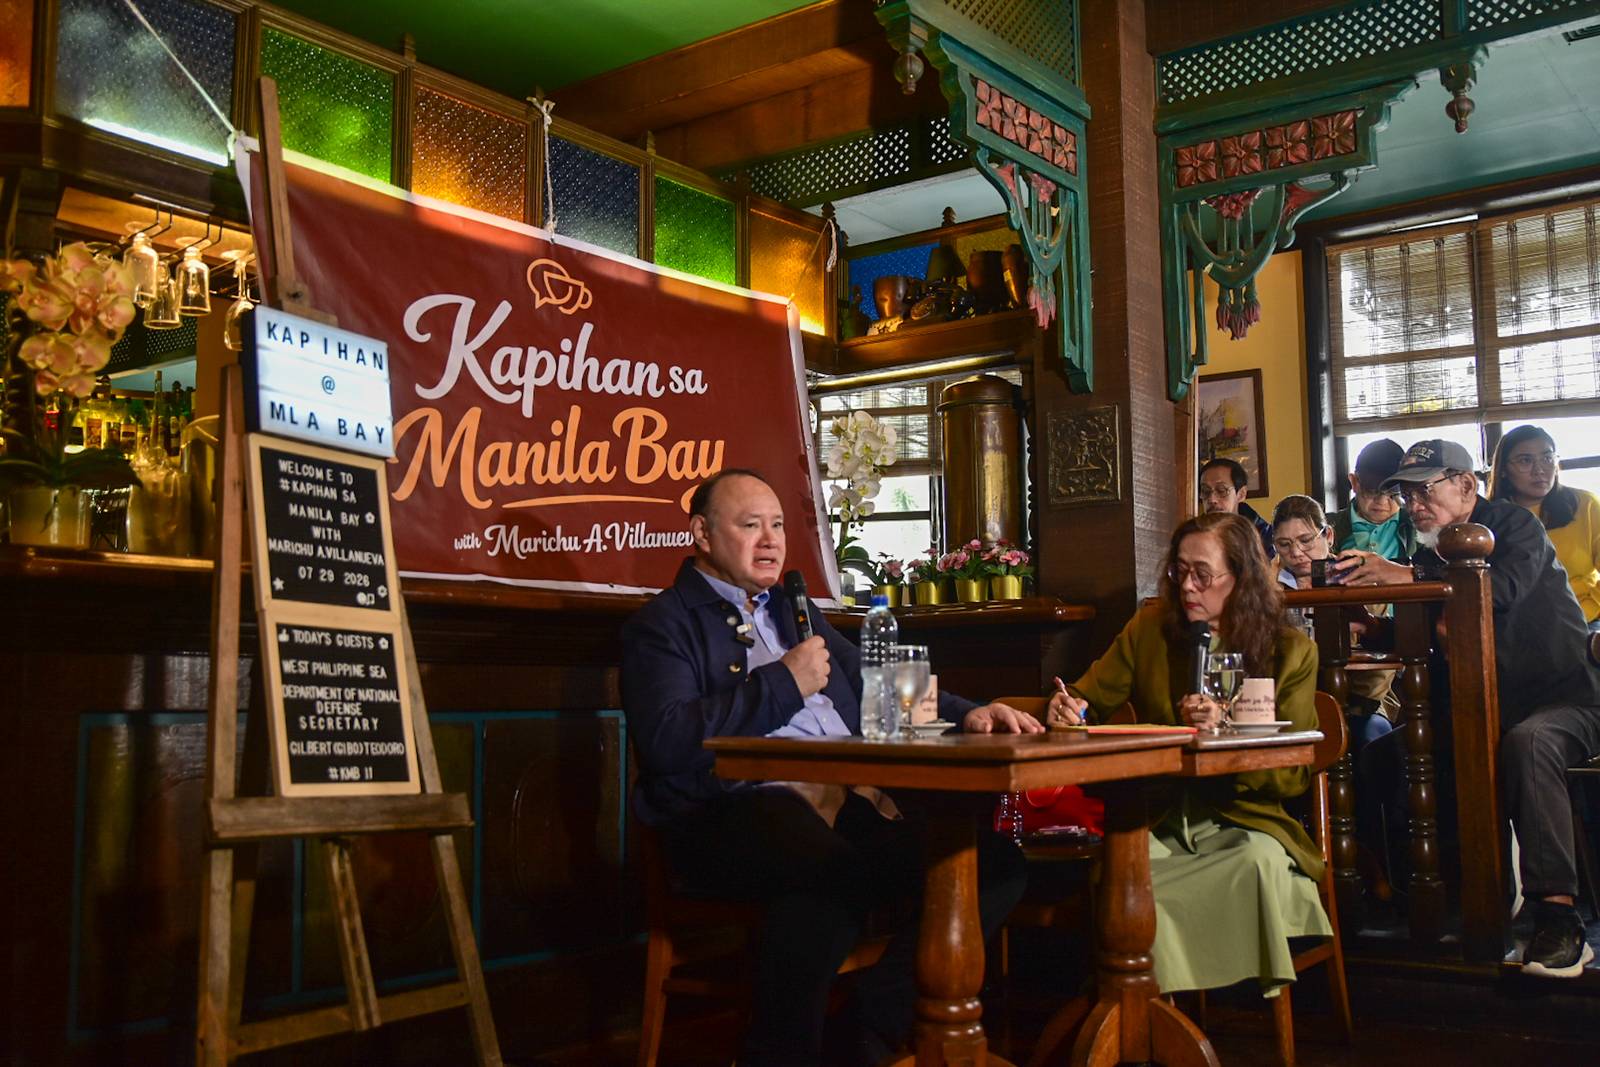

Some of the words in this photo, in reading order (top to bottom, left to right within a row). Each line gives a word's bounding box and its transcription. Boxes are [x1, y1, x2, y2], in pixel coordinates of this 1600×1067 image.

[266, 321, 384, 370] KAPIHAN
[403, 294, 665, 418] Kapihan
[669, 366, 708, 395] sa
[321, 375, 336, 395] @
[270, 400, 320, 431] MLA
[337, 418, 385, 444] BAY
[389, 405, 617, 510] Manila
[278, 459, 334, 481] WELCOME
[340, 471, 354, 485] TO
[279, 478, 338, 500] #KAPIHAN
[342, 490, 357, 503] SA
[289, 503, 333, 523] MANILA
[340, 511, 360, 526] BAY
[312, 525, 342, 542] WITH
[453, 532, 482, 550] with
[484, 524, 581, 559] Marichu
[583, 521, 694, 553] A.Villanuev
[268, 538, 314, 558] MARICHU
[298, 566, 313, 579] 07
[336, 634, 375, 649] GUESTS
[282, 659, 310, 674] WEST
[312, 662, 366, 678] PHILIPPINE
[369, 665, 388, 679] SEA
[282, 684, 342, 700] DEPARTMENT
[344, 687, 357, 701] OF
[358, 689, 401, 703] NATIONAL
[316, 701, 363, 716] DEFENSE
[299, 715, 380, 731] SECRETARY
